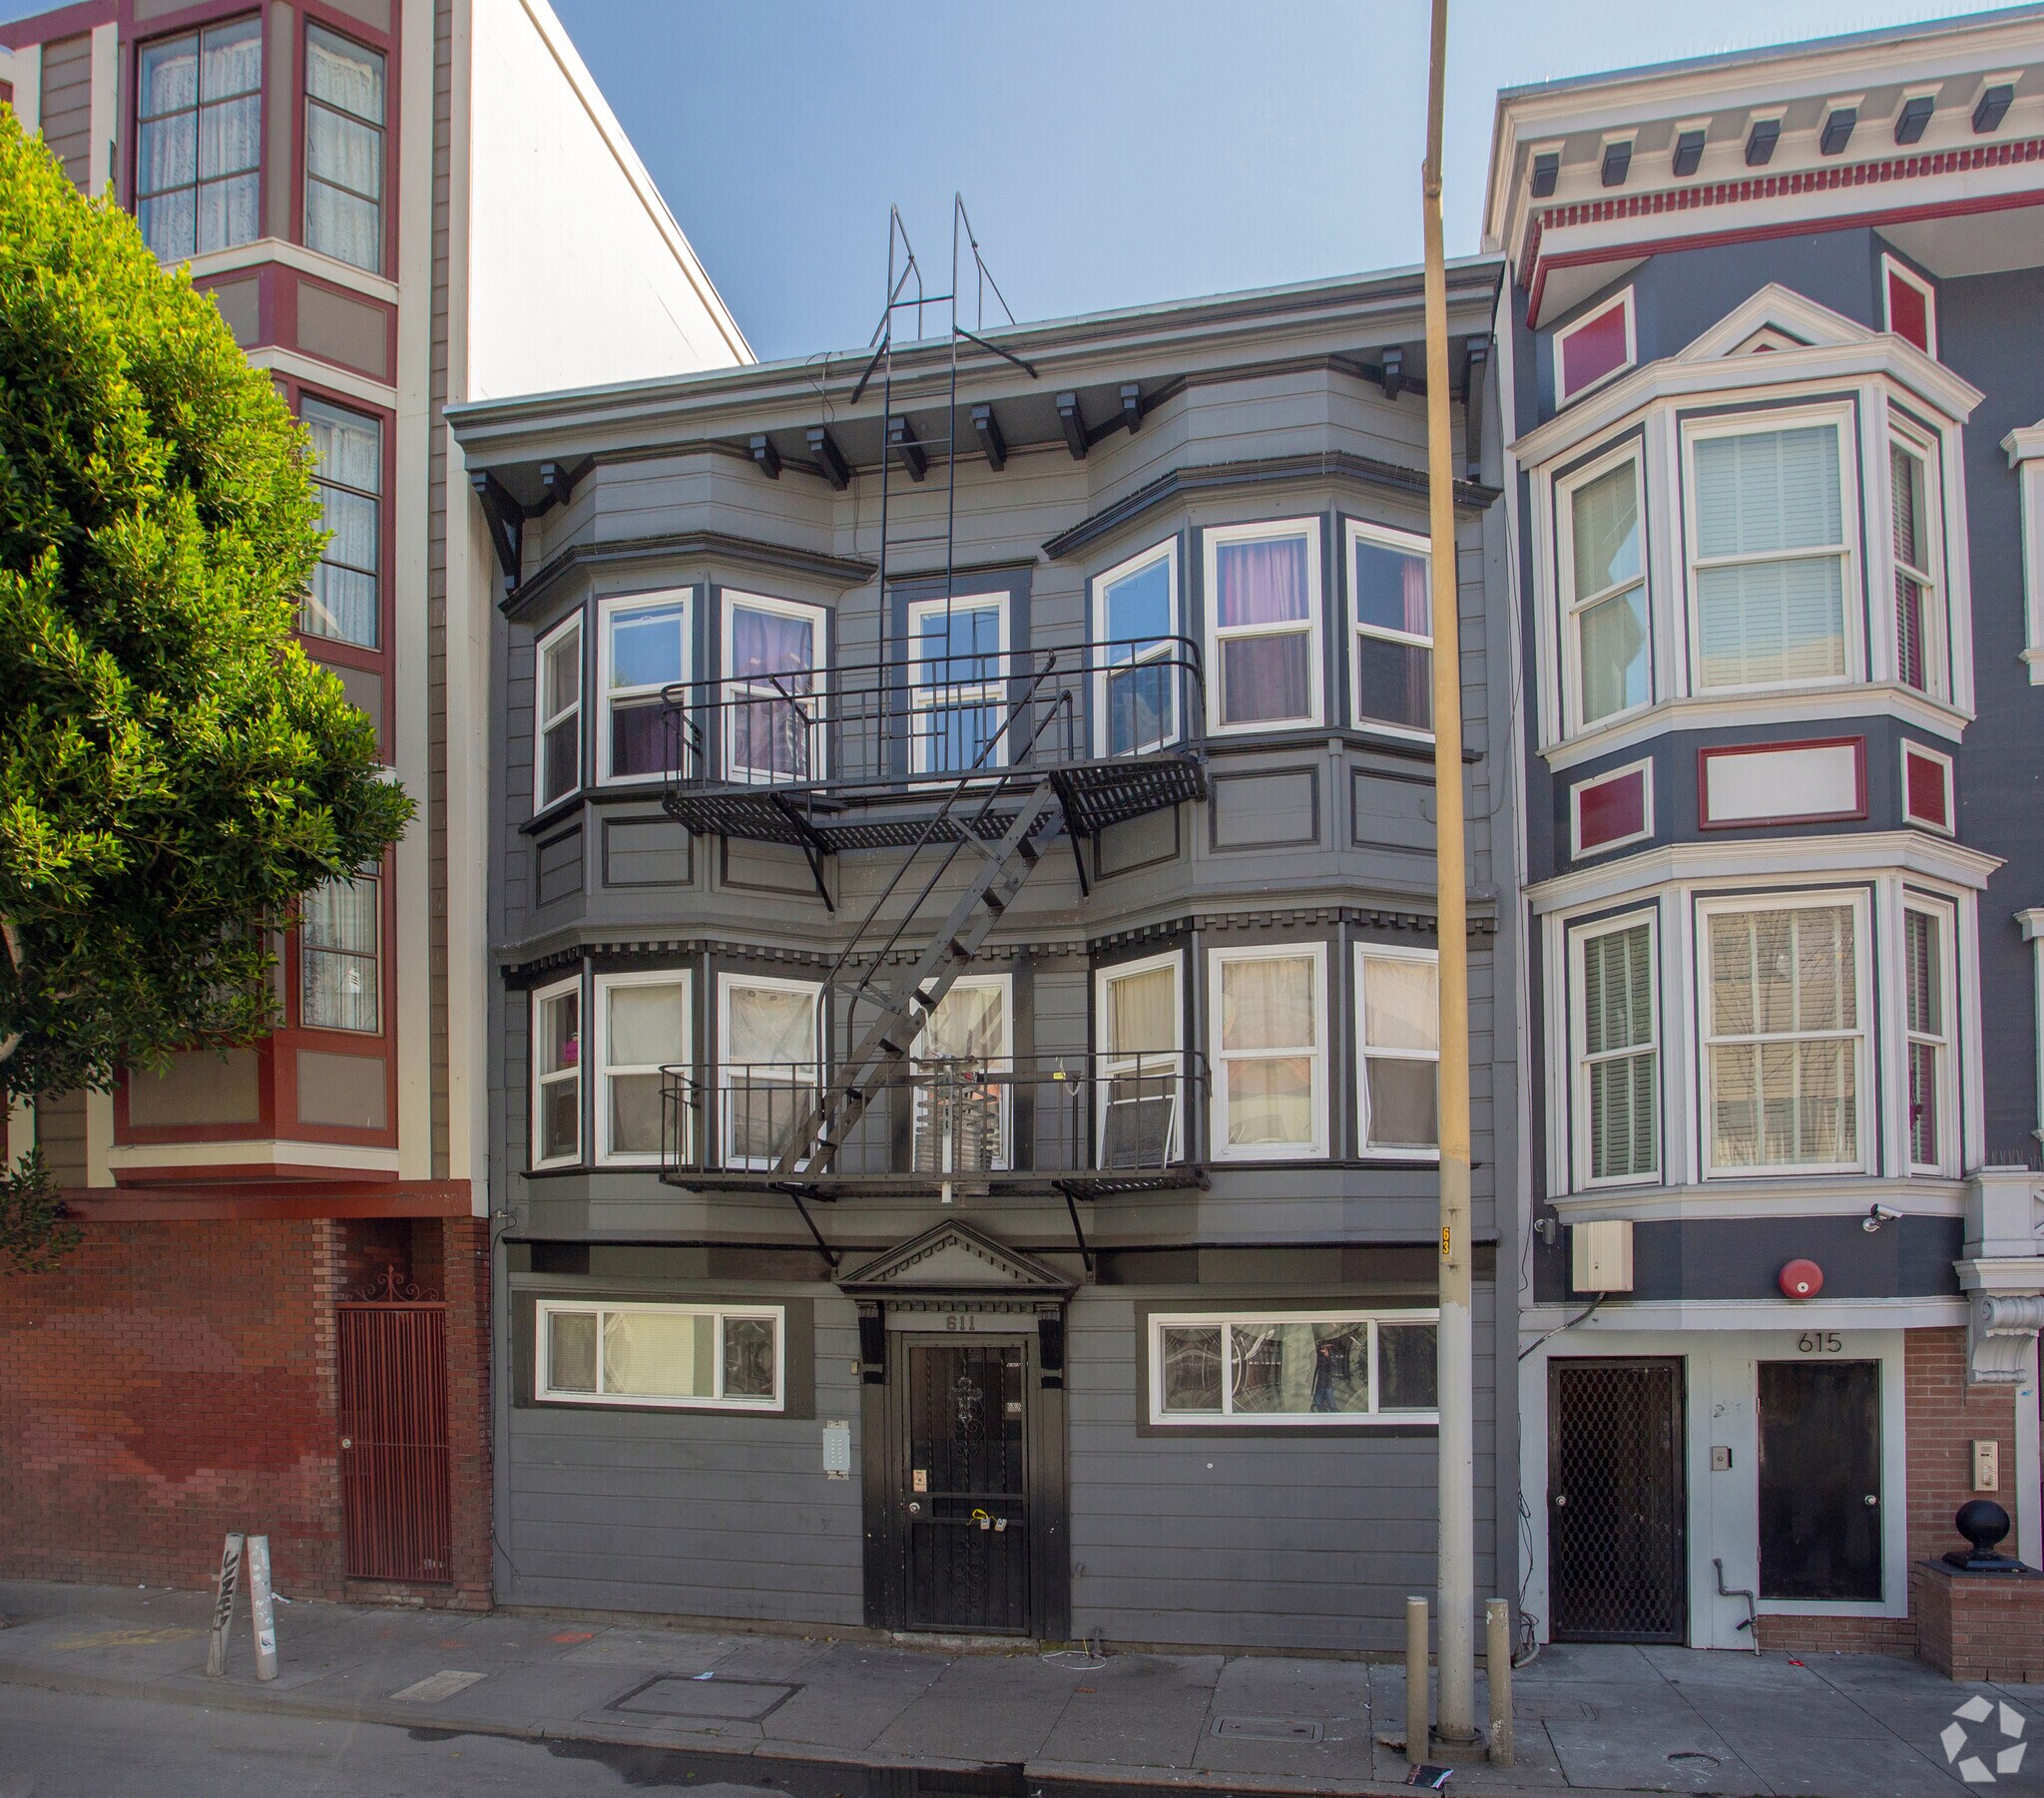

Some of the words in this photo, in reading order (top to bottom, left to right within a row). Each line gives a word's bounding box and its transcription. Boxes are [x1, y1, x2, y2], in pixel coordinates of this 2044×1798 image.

[1442, 1227, 1450, 1254] 63
[946, 1314, 976, 1331] 611
[1798, 1332, 1842, 1353] 615
